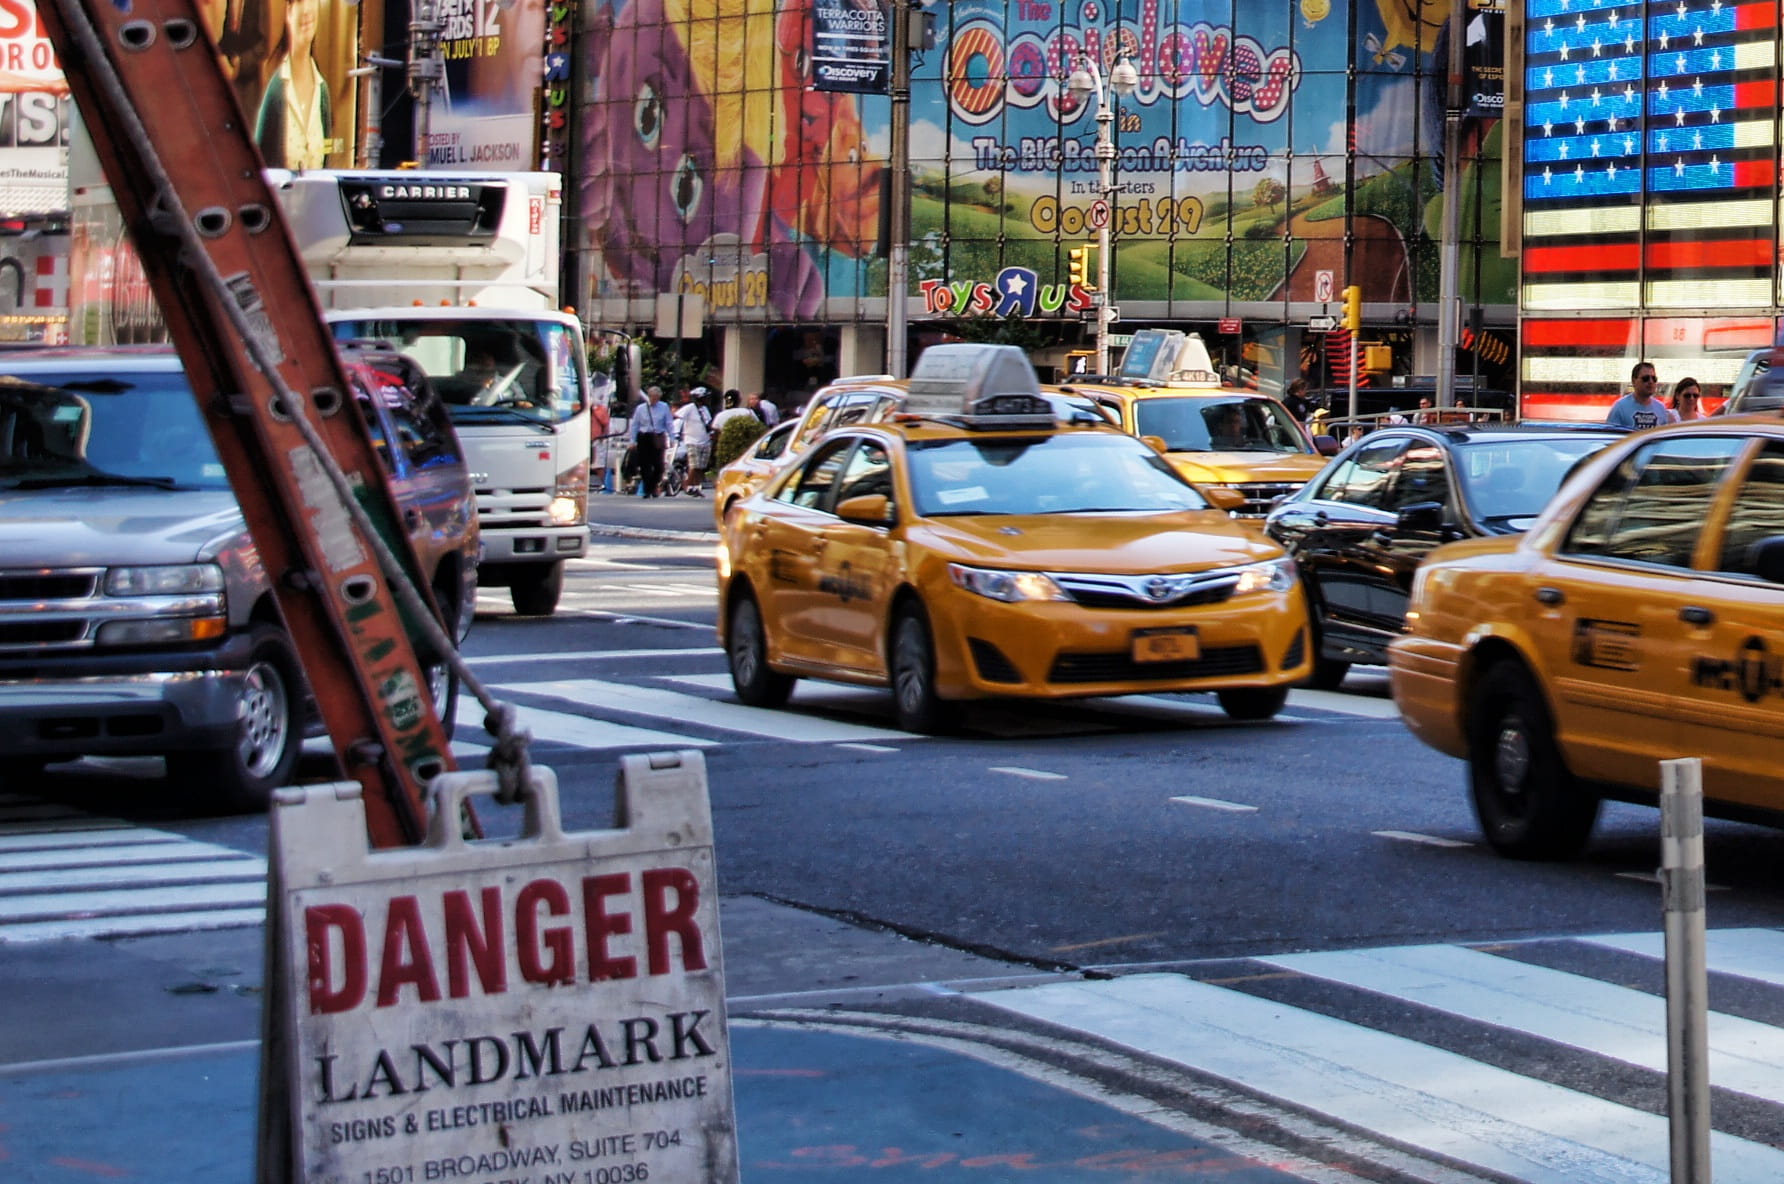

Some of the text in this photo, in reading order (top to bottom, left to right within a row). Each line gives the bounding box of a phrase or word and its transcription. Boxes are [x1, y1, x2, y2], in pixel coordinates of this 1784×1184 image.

[816, 7, 885, 22] TERRACOTTA
[828, 19, 885, 32] WARRIORS
[452, 38, 476, 59] JULY
[1119, 107, 1141, 133] in
[451, 133, 460, 144] BY
[470, 143, 520, 163] JACKSON
[973, 137, 1018, 171] The
[1021, 137, 1062, 171] BIG
[383, 186, 470, 199] CARRIER
[1071, 180, 1085, 194] In
[1156, 195, 1205, 235] 29
[744, 270, 769, 308] 29
[304, 866, 708, 1016] DANGER
[315, 1010, 717, 1107] LANDMARK
[330, 1075, 708, 1145] SIGNS & ELECTRICAL MAINTENANCE
[364, 1164, 415, 1184] 1501
[425, 1144, 563, 1182] BROADWAY,
[569, 1133, 636, 1163] SUITE
[642, 1129, 683, 1153] 704
[584, 1161, 649, 1184] 10036
